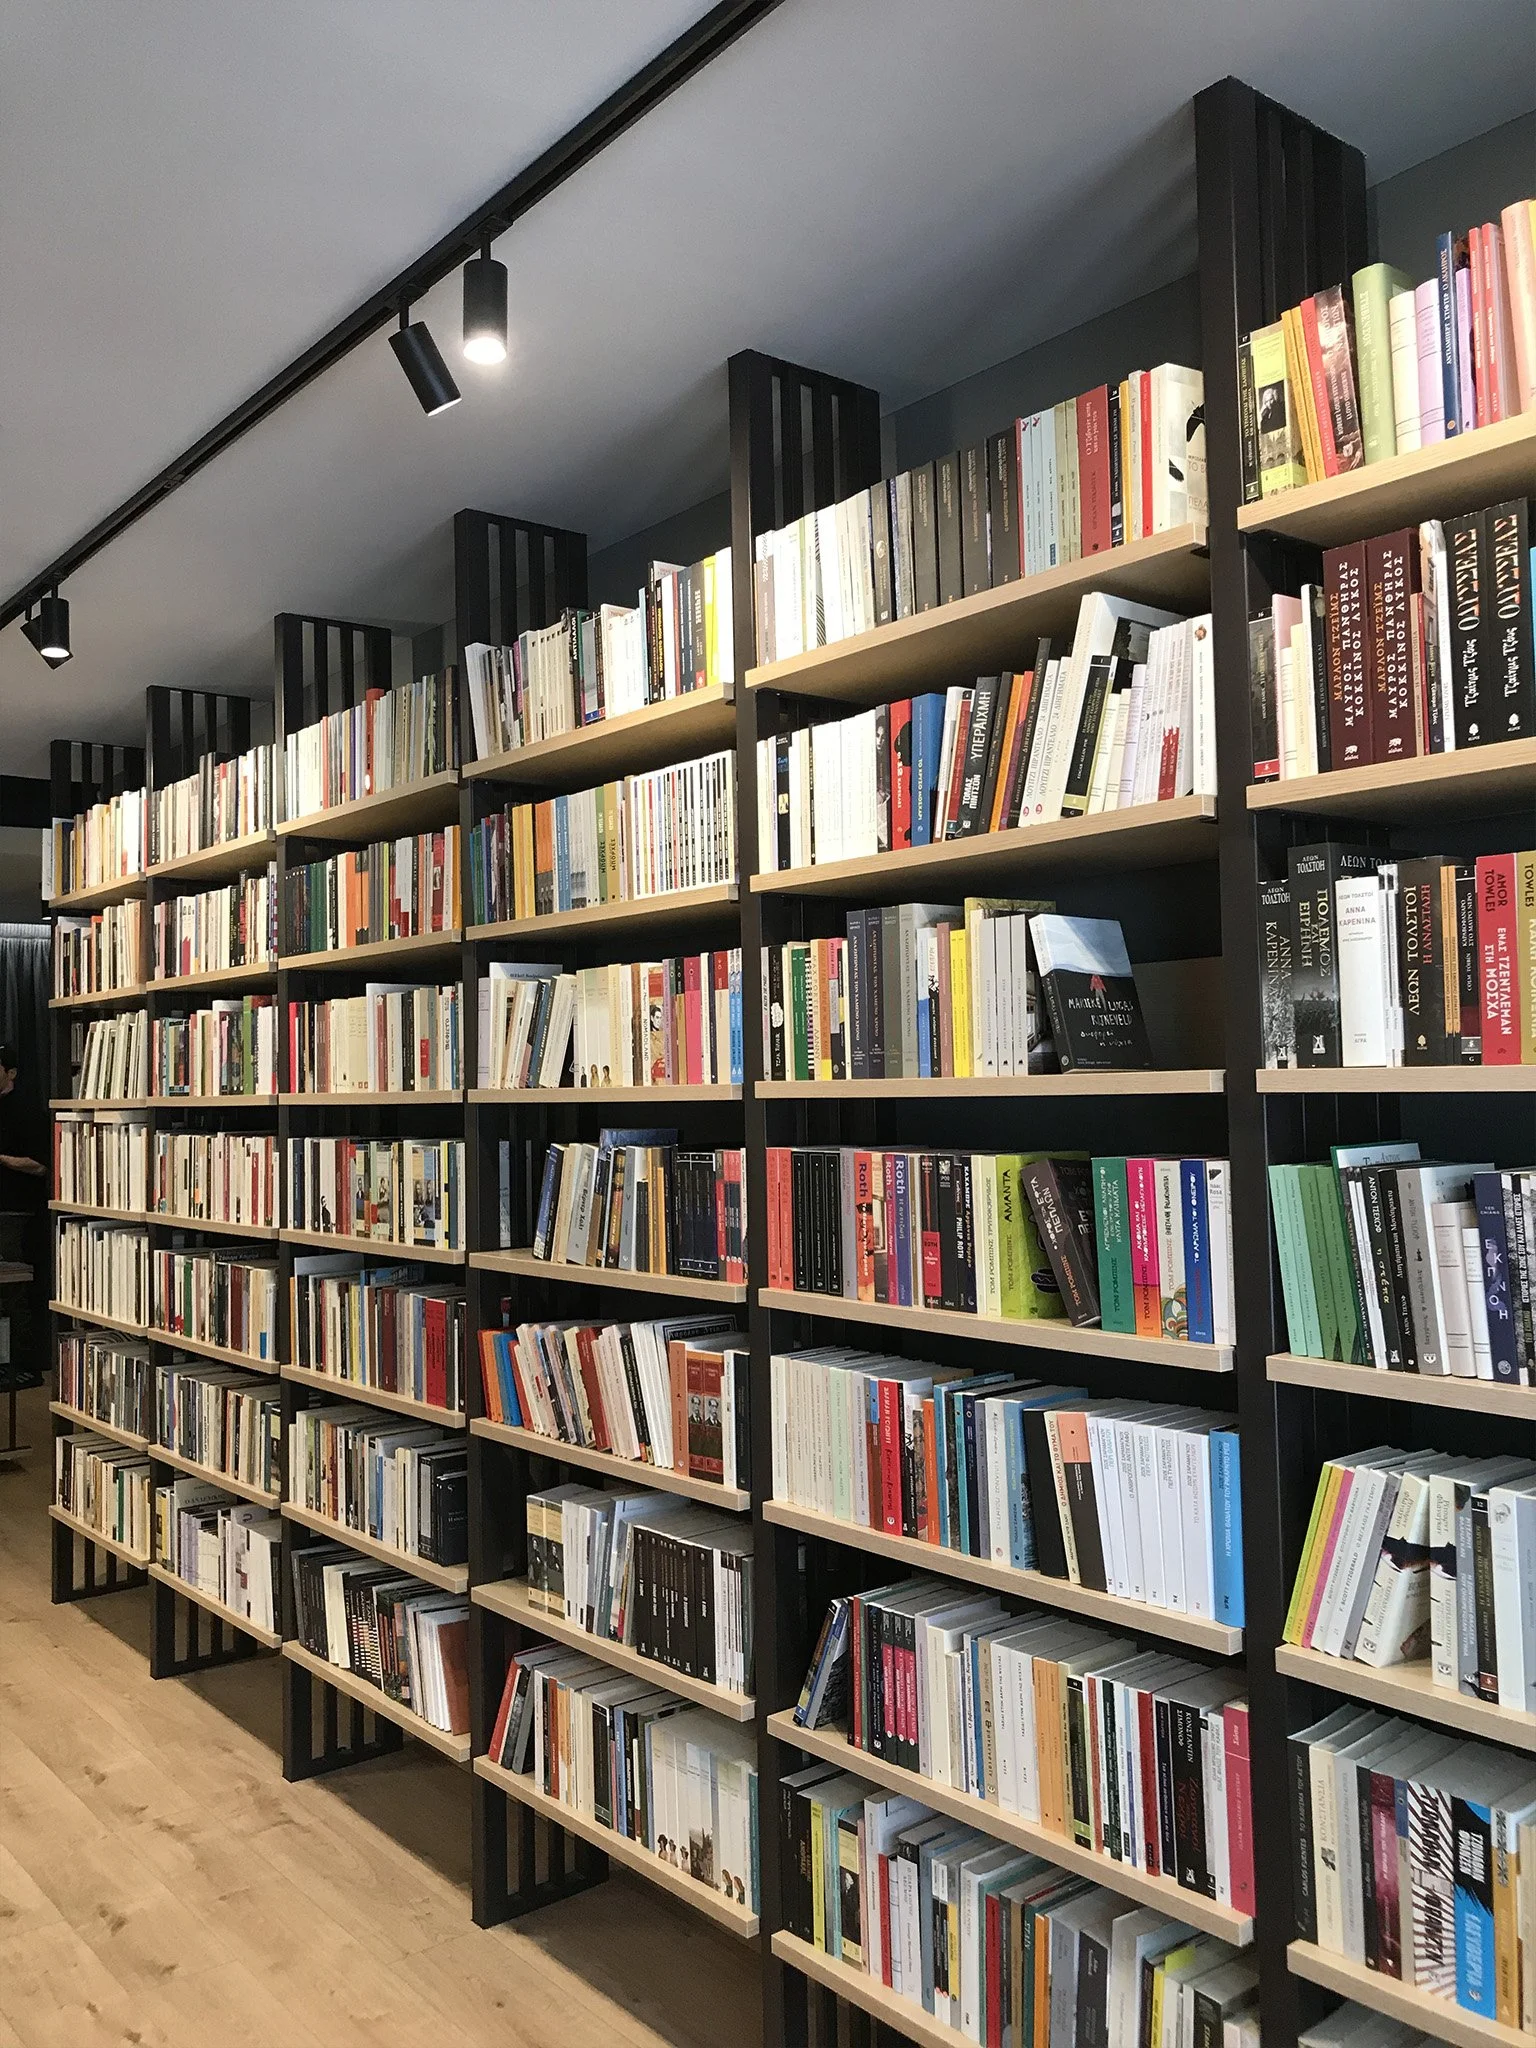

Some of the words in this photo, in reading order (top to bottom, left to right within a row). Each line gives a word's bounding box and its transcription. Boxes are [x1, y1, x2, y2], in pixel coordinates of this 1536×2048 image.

[1394, 556, 1404, 611] ΛΥΚΟΣ
[1454, 528, 1480, 631] ΟΔΥΣΣΕΑΣ
[1494, 514, 1520, 619] ΟΔΥΣΣΕΑΣ
[1339, 561, 1351, 648] ΠΑΝΘΗΡΑΣ
[1350, 567, 1360, 621] ΛΥΚΟΣ
[1374, 582, 1384, 633] ΤΖΕΪΜΣ
[1383, 550, 1395, 640] ΠΑΝΘΗΡΑΣ
[1329, 592, 1339, 641] ΤΖΕΪΜΣ
[1333, 647, 1342, 701] ΜΑΡΛΟΝ
[1352, 630, 1364, 716] ΚΟΚΚΙΝΟΣ
[1376, 637, 1386, 692] ΜΑΡΛΟΝ
[1387, 653, 1398, 719] ΜΑΥΡΟΣ
[1396, 620, 1408, 708] ΚΟΚΚΙΝΟΣ
[1343, 662, 1354, 726] ΜΑΥΡΟΣ
[970, 691, 992, 760] ΥΠΕΡΑΙΧΜΗ
[1030, 727, 1044, 769] ΠΙΡΑΝΤΕΛΛΟ
[1041, 673, 1053, 713] ΔΙΗΓΗΜΑΤΑ
[1044, 725, 1057, 766] ΠΙΡΑΝΤΕΛΛΟ
[1054, 671, 1067, 710] ΔΙΗΓΗΜΑΤΑ
[918, 758, 923, 768] ΤΟ
[962, 778, 973, 805] ΤΟΜΑΣ
[971, 774, 981, 809] ΠΙΝΤΣΟΝ
[1340, 855, 1366, 868] ΛΕΩΝ
[1484, 869, 1496, 912] TOWLES
[1497, 874, 1507, 906] AMOR
[1524, 864, 1534, 908] TOWLES
[1339, 917, 1376, 926] ΚΑΡΕΝΙΝΑ
[1345, 906, 1365, 914] ΑΝΝΑ
[1404, 886, 1418, 962] ΤΟΛΣΤΟΪ
[1421, 884, 1432, 950] ΑΝΑΣΤΑΣΗ
[1298, 901, 1313, 967] ΕΙΡΗΝΗ
[1311, 924, 1320, 944] ΚΑΙ
[1316, 889, 1332, 977] ΠΟΛΕΜΟΣ
[1484, 945, 1494, 963] ΣΤΗ
[1497, 927, 1507, 952] ΕΝΑΣ
[1266, 921, 1282, 999] ΚΑΡΕΝΙΝΑ
[1279, 936, 1291, 980] ΑΝΝΑ
[1423, 954, 1432, 964] Η
[1068, 998, 1101, 1009] MARIEKE
[1407, 969, 1420, 1016] ΛΕΩΝ
[1486, 968, 1498, 1019] ΜΟΣΧΑ
[1499, 956, 1512, 1035] ΤΖΕΝΤΛΕΜΑΝ
[858, 1163, 868, 1197] Roth
[896, 1160, 905, 1194] Roth
[1003, 1169, 1012, 1222] ΑΜΑΝΤΑ
[1030, 1176, 1045, 1205] ΕΦΤΑ
[1368, 1176, 1378, 1204] ΑΝΤΟΝ
[1043, 1186, 1063, 1234] ΠΕΠΛΩΝ
[1371, 1206, 1382, 1233] ΤΣΕΧΩΦ
[1073, 1290, 1082, 1306] ΤΟΜ
[1048, 1419, 1056, 1433] ΤΟΥ
[1051, 1433, 1059, 1452] ΘΥΜΑ
[1054, 1453, 1060, 1462] ΤΟ
[1057, 1475, 1067, 1500] ΔΗΜΙΟΣ
[1344, 1552, 1359, 1587] FITZGERALD
[1340, 1588, 1350, 1605] SCOTT
[1177, 1709, 1185, 1746] ΣΙΜΟΝΟΦ
[1185, 1711, 1194, 1763] ΚΟΝΣΤΑΝΤΙΝ
[1300, 1838, 1308, 1867] FUENTES
[1301, 1868, 1309, 1896] CARLOS
